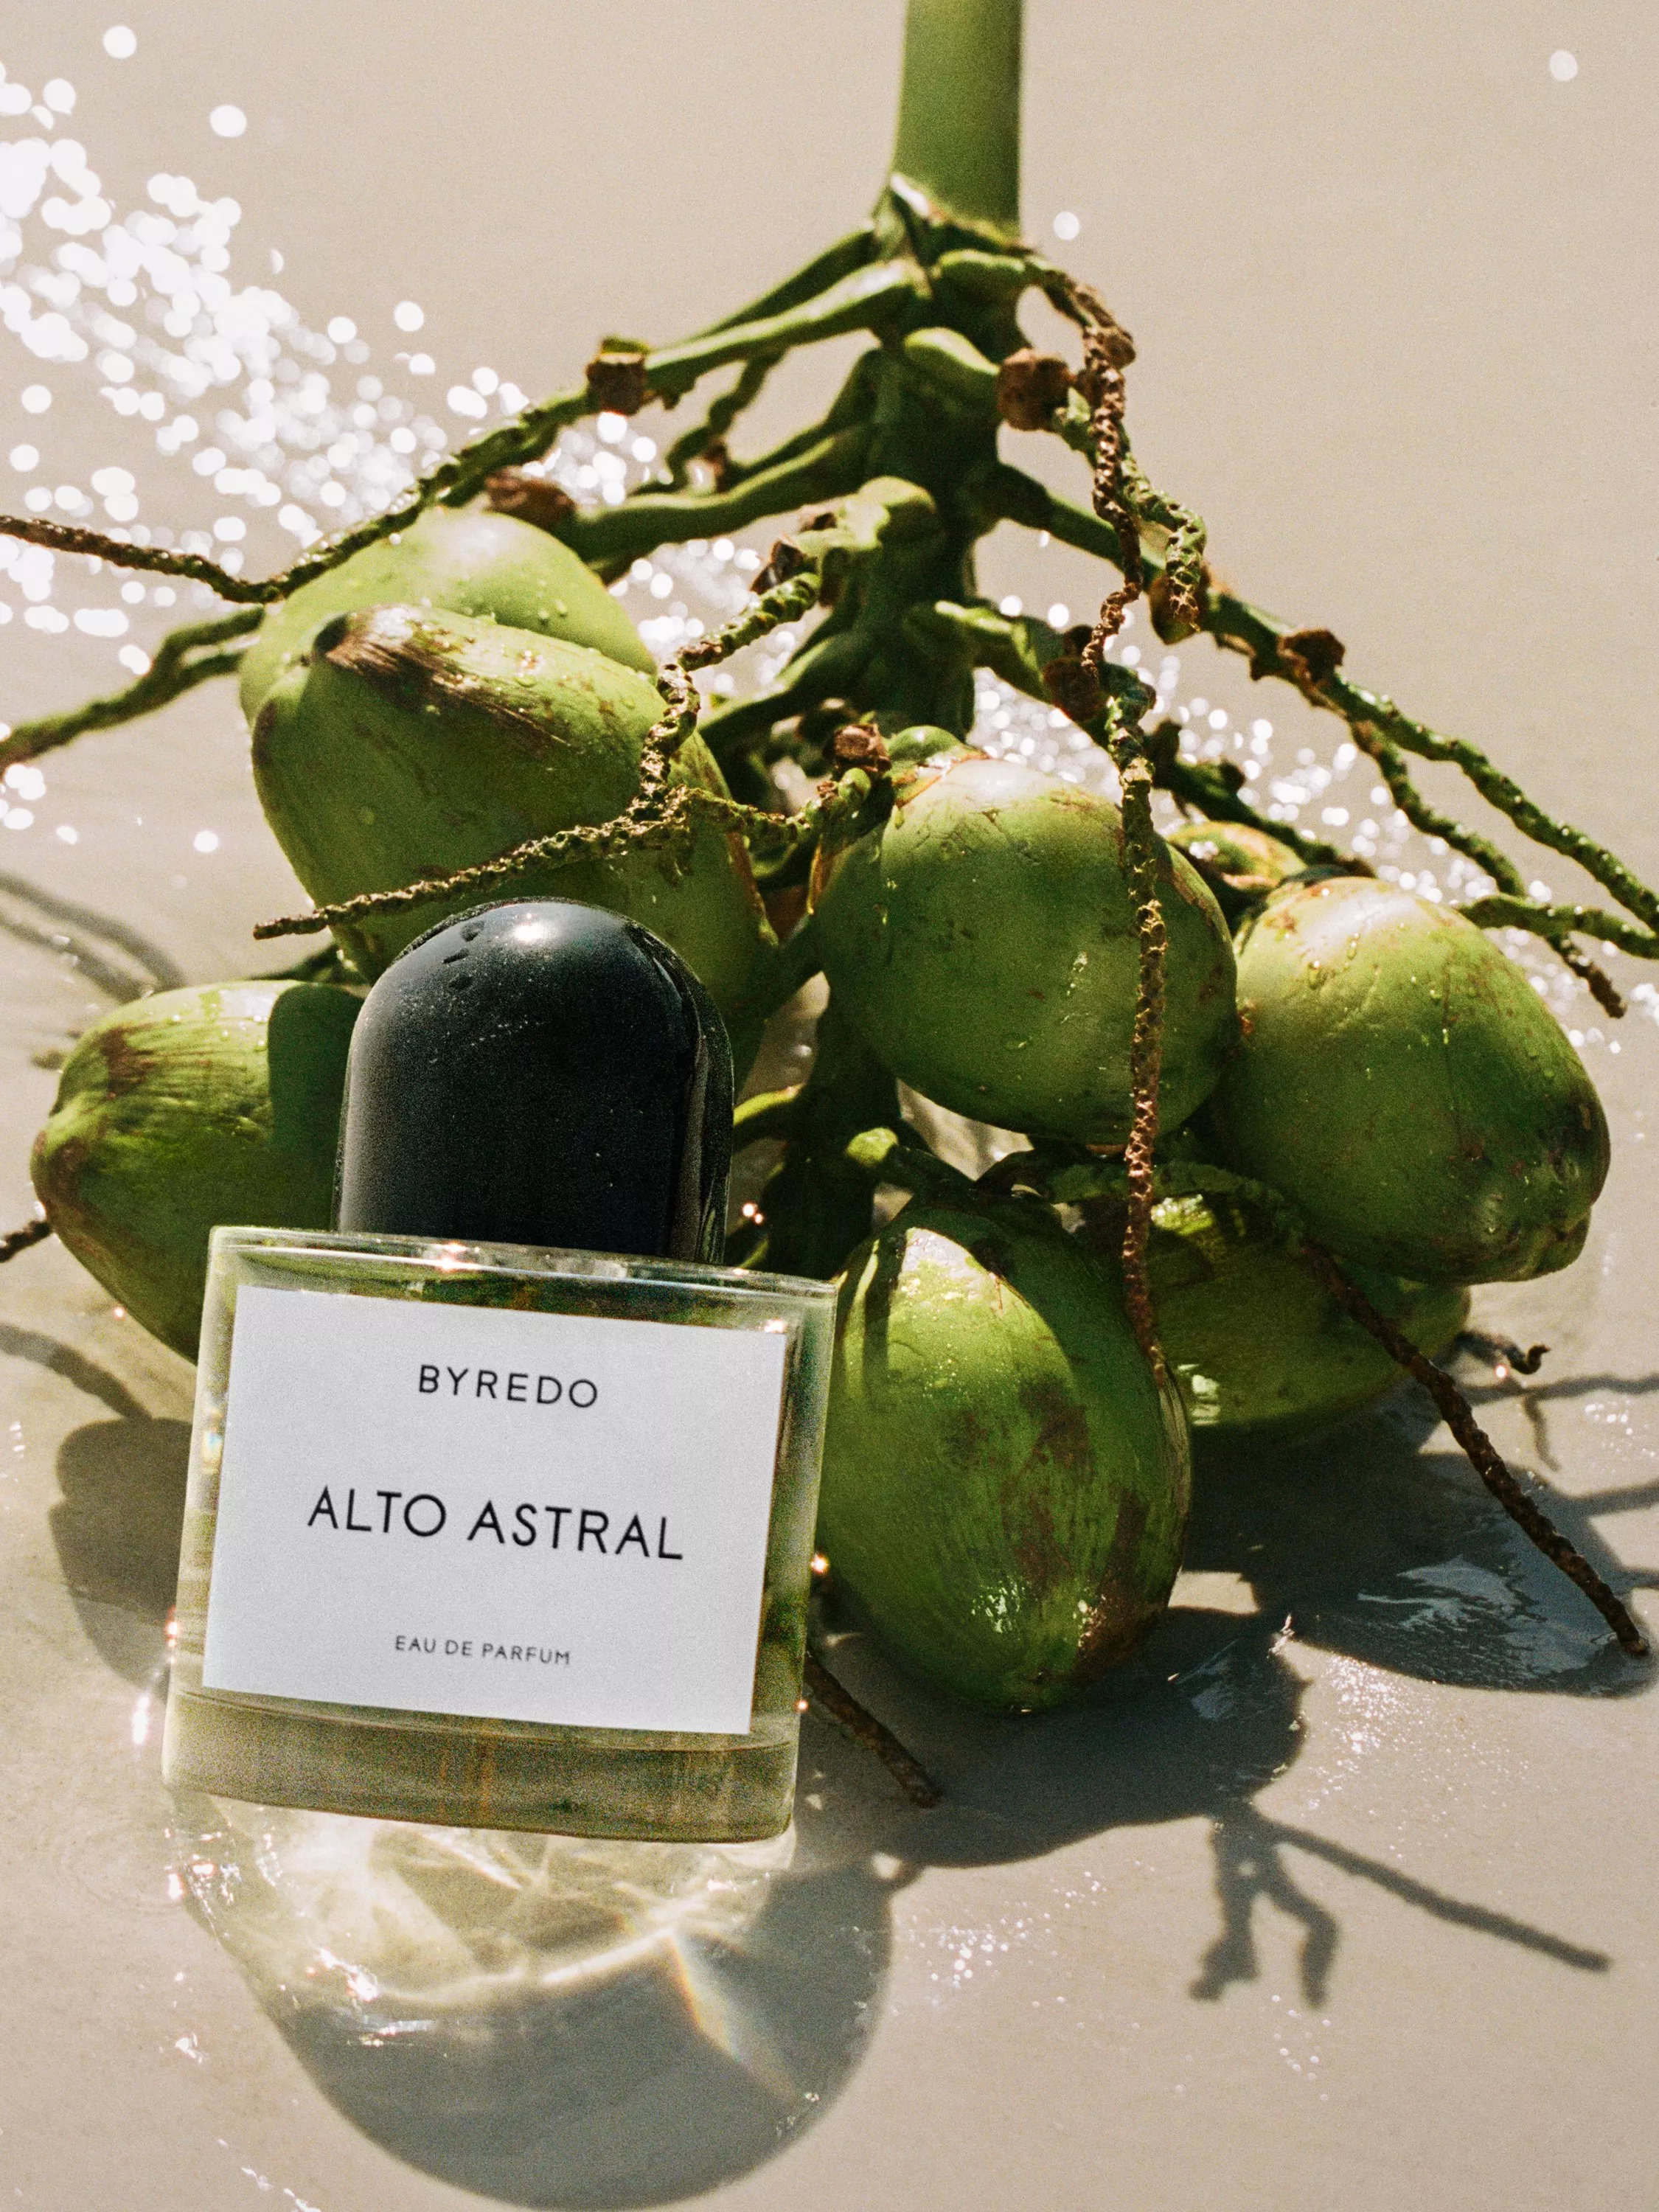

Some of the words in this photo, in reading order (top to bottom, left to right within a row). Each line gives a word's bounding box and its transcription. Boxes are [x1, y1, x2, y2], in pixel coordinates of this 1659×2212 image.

[418, 1363, 598, 1408] BYREDO
[307, 1485, 447, 1538] ALTO
[467, 1499, 684, 1560] ASTRAL
[394, 1635, 437, 1653] EAU
[445, 1639, 473, 1657] DE
[481, 1643, 571, 1665] PARFUM
